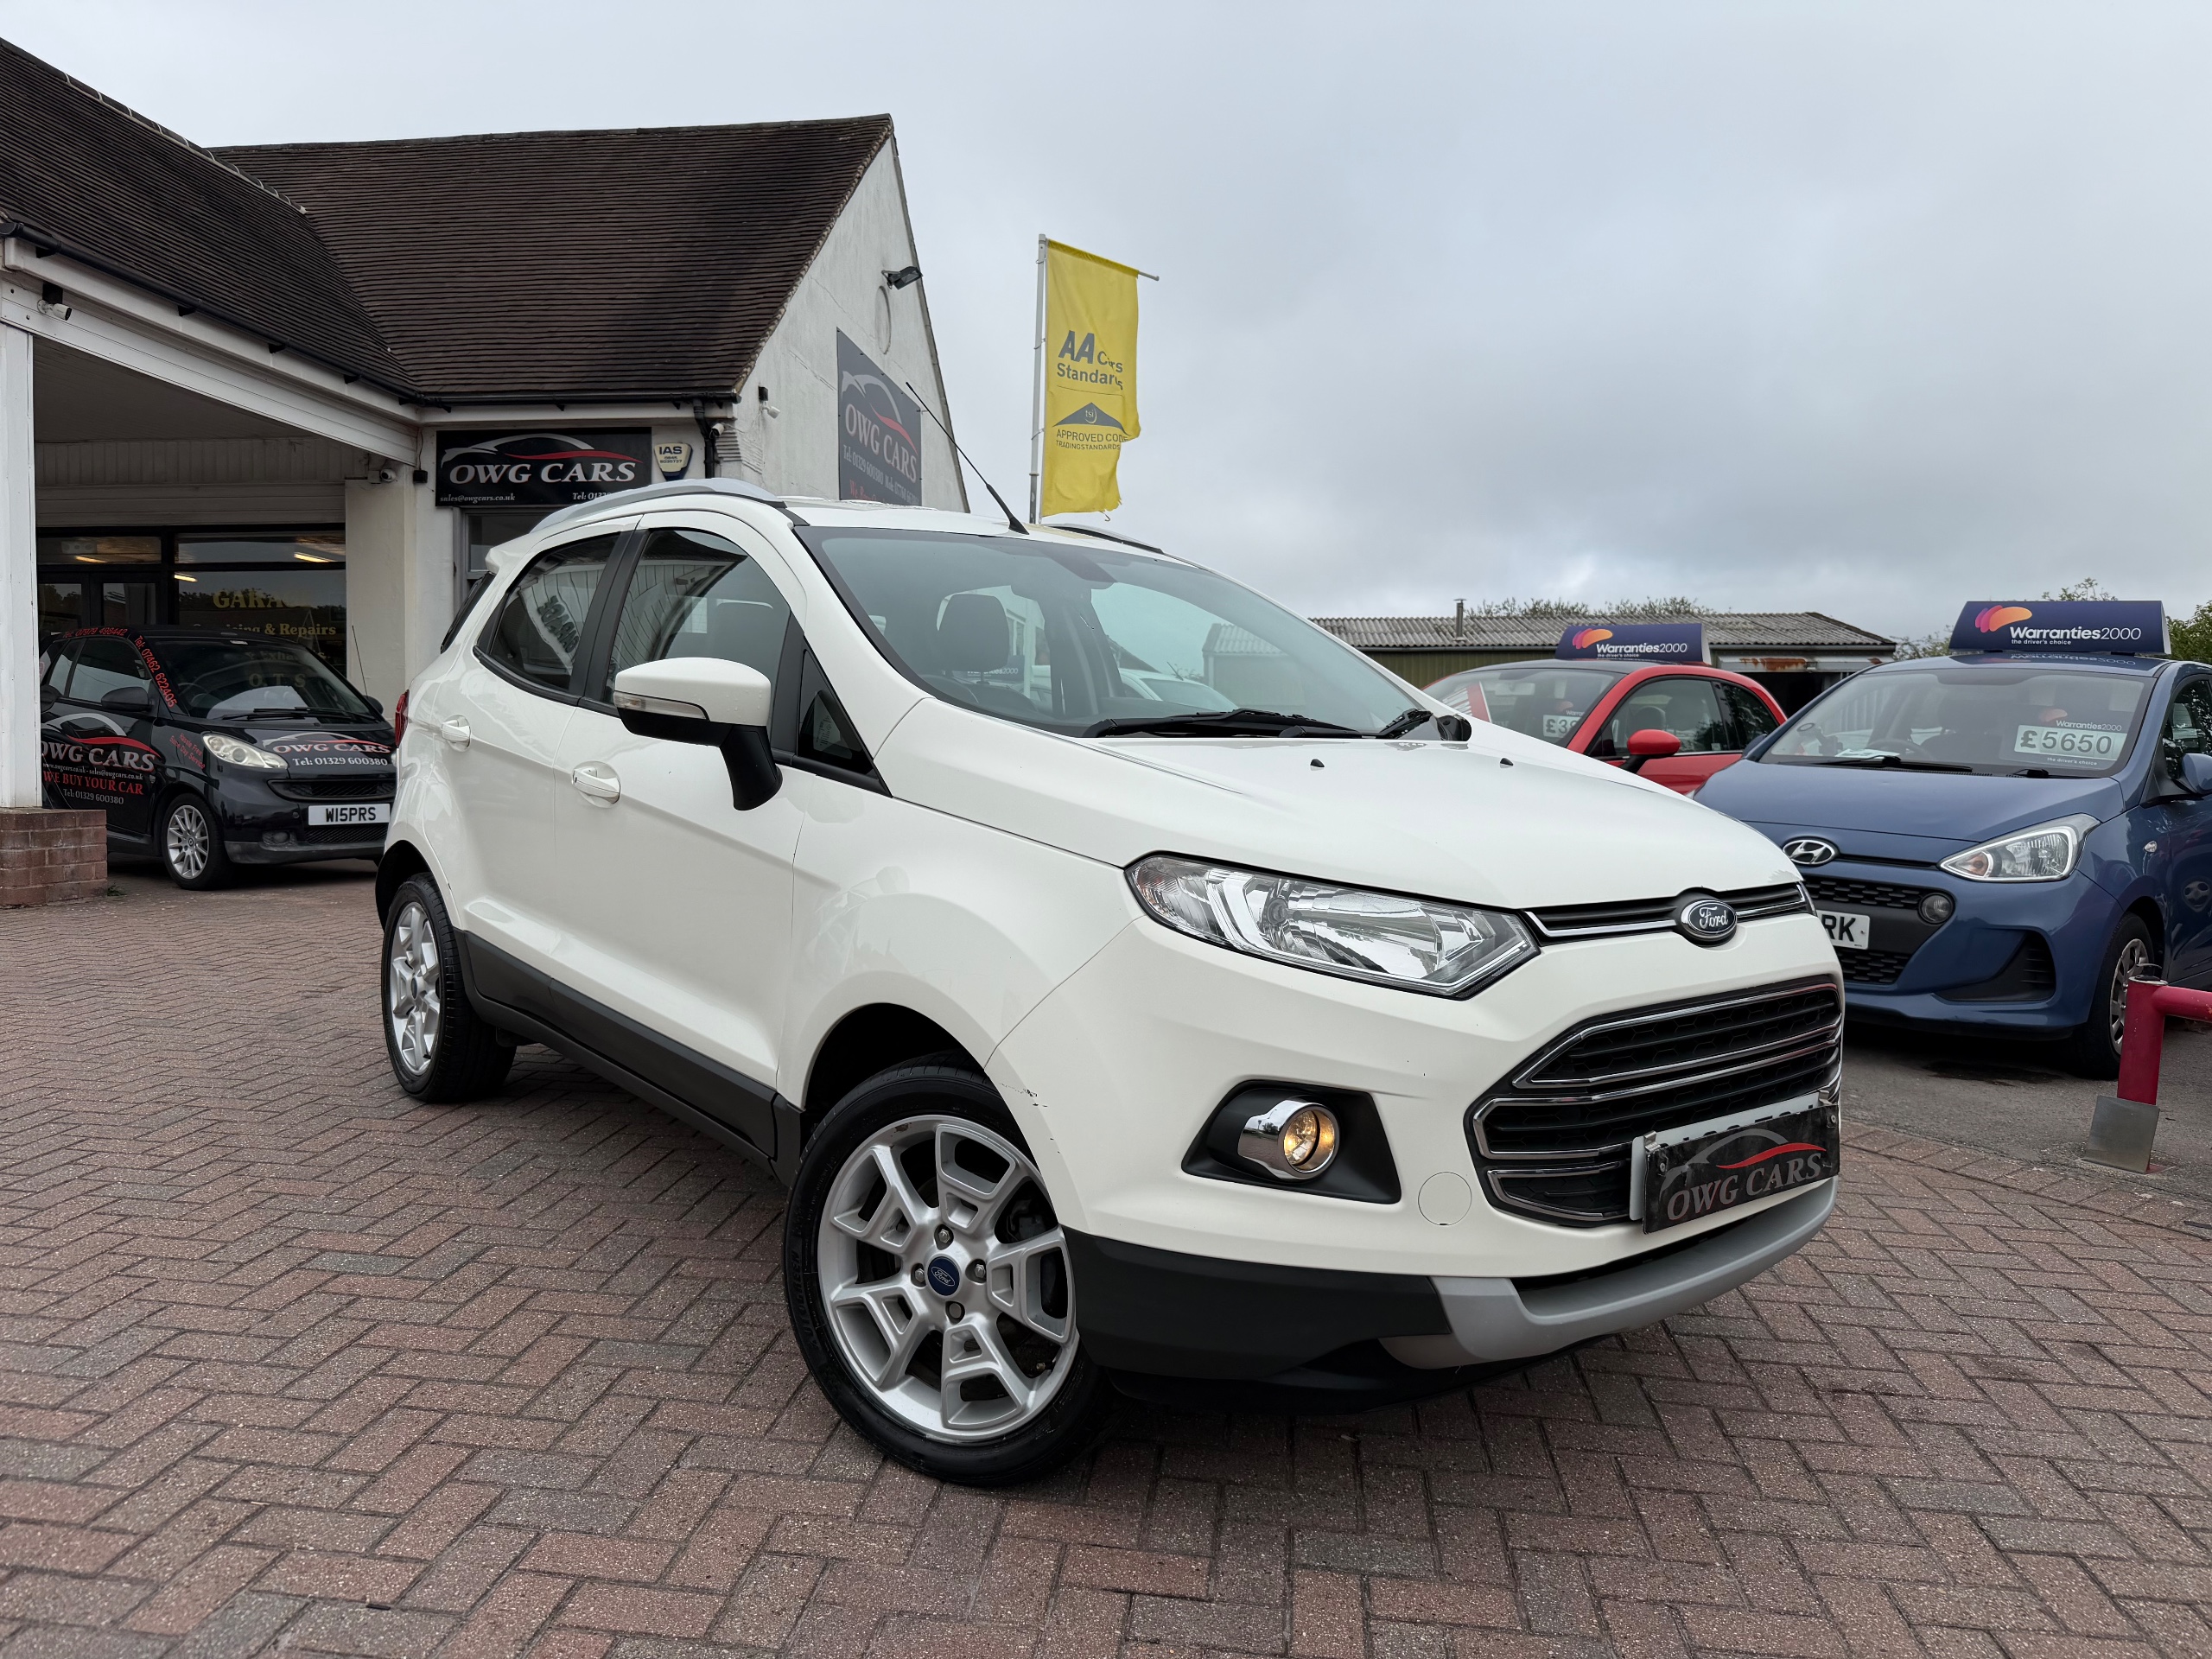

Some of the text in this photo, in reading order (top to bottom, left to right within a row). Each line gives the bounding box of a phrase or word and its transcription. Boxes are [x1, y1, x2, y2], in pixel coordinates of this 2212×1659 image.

[1058, 330, 1096, 365] AA
[1056, 429, 1104, 442] APPROVED
[659, 446, 683, 455] IAS
[845, 403, 917, 484] OWG CARS
[449, 461, 637, 484] OWG CARS
[440, 493, 516, 504] sales@owgcars.co.uk
[572, 492, 587, 500] Tel:
[279, 623, 336, 637] Repairs
[2009, 626, 2142, 640] Warranties2000
[1596, 642, 1688, 653] Warranties2000
[134, 635, 178, 708] Tel: 07462 622405
[2056, 720, 2123, 732] Warranties2000
[273, 743, 391, 753] OWG CARS
[2020, 730, 2112, 754] £5650
[89, 747, 156, 772] CARS
[292, 757, 388, 766] Tel: 01329 600380
[43, 770, 144, 795] WE BUY YOUR CAR
[63, 788, 124, 804] Tel: 01329 600380
[1699, 906, 1729, 930] Ford
[1667, 1153, 1822, 1221] OWG CARS
